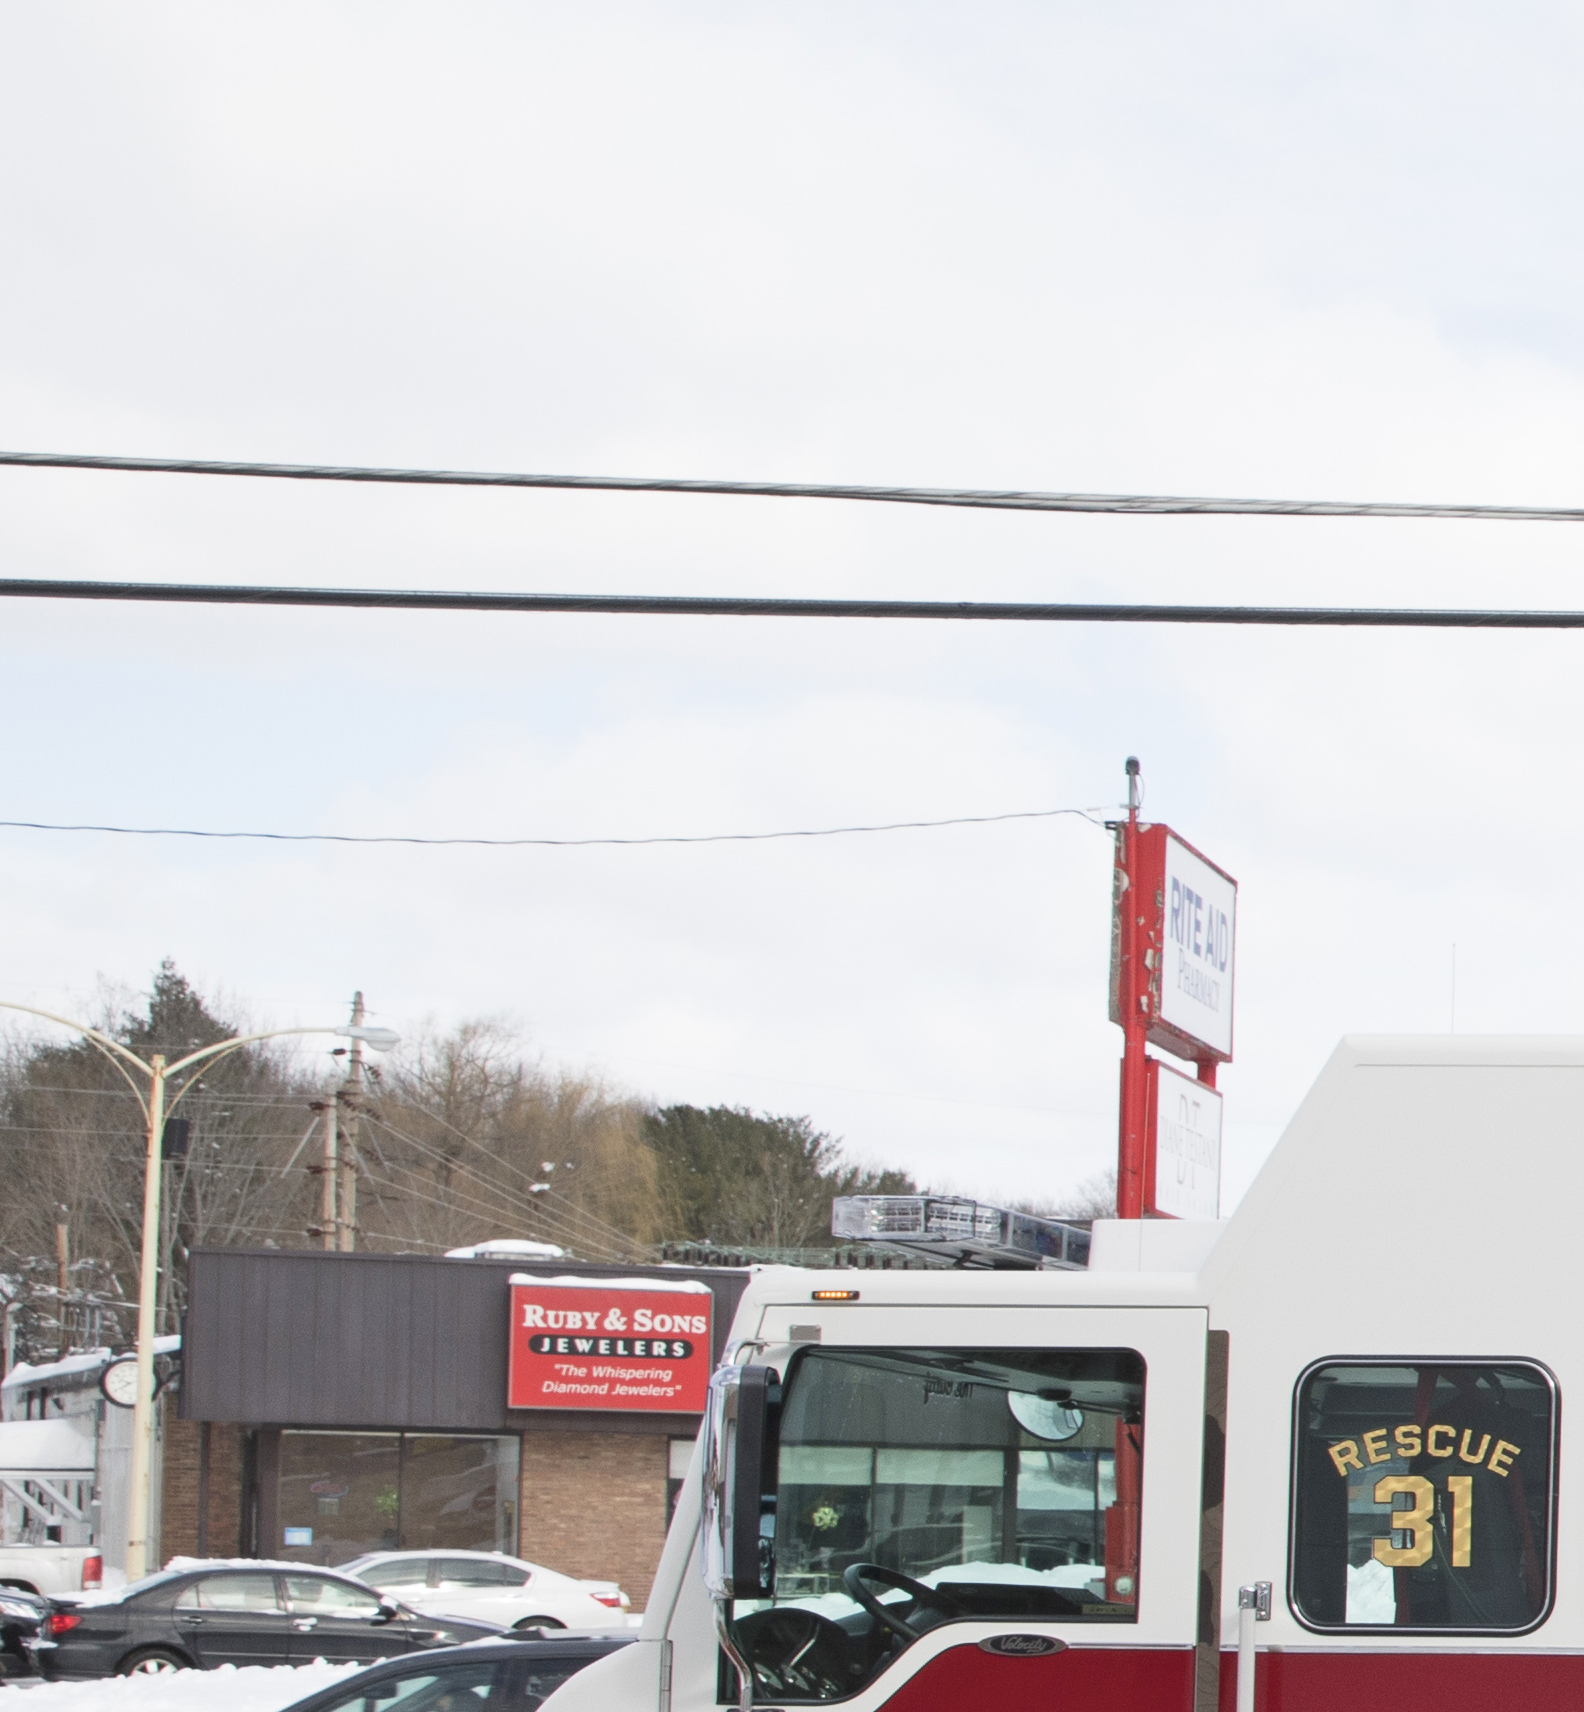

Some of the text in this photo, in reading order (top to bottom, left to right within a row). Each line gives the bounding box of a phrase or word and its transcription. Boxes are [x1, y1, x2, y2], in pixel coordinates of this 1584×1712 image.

[1169, 875, 1229, 974] RITE AID
[522, 1304, 707, 1335] RUBY & SONS
[540, 1337, 685, 1357] JEWELERS
[554, 1363, 673, 1382] "The Whispering
[542, 1381, 682, 1397] Diamond Jewelers"
[1327, 1423, 1522, 1479] RESCUE
[1371, 1474, 1474, 1569] 31
[1000, 1636, 1047, 1653] Velocity
